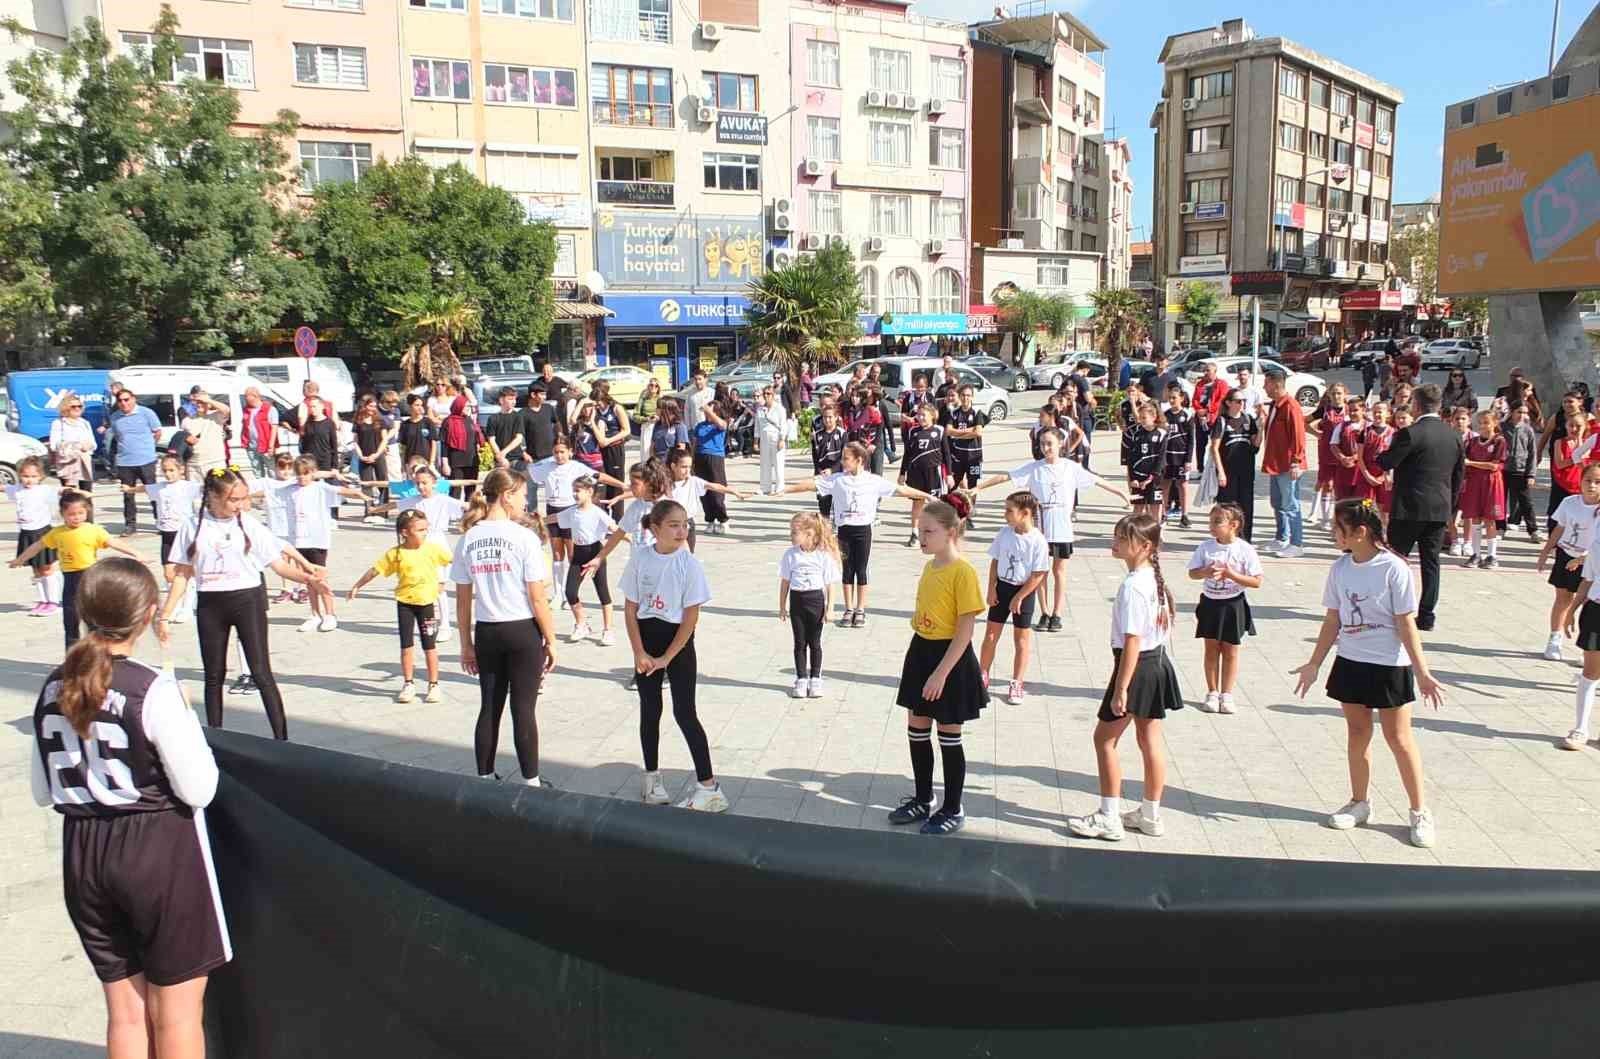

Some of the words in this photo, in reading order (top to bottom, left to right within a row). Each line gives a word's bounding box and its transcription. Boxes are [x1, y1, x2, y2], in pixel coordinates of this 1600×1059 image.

[720, 116, 766, 131] AVUKAT
[623, 183, 672, 194] AVUKAT
[624, 238, 679, 257] bağlan
[918, 438, 930, 449] 27
[42, 713, 142, 806] 26
